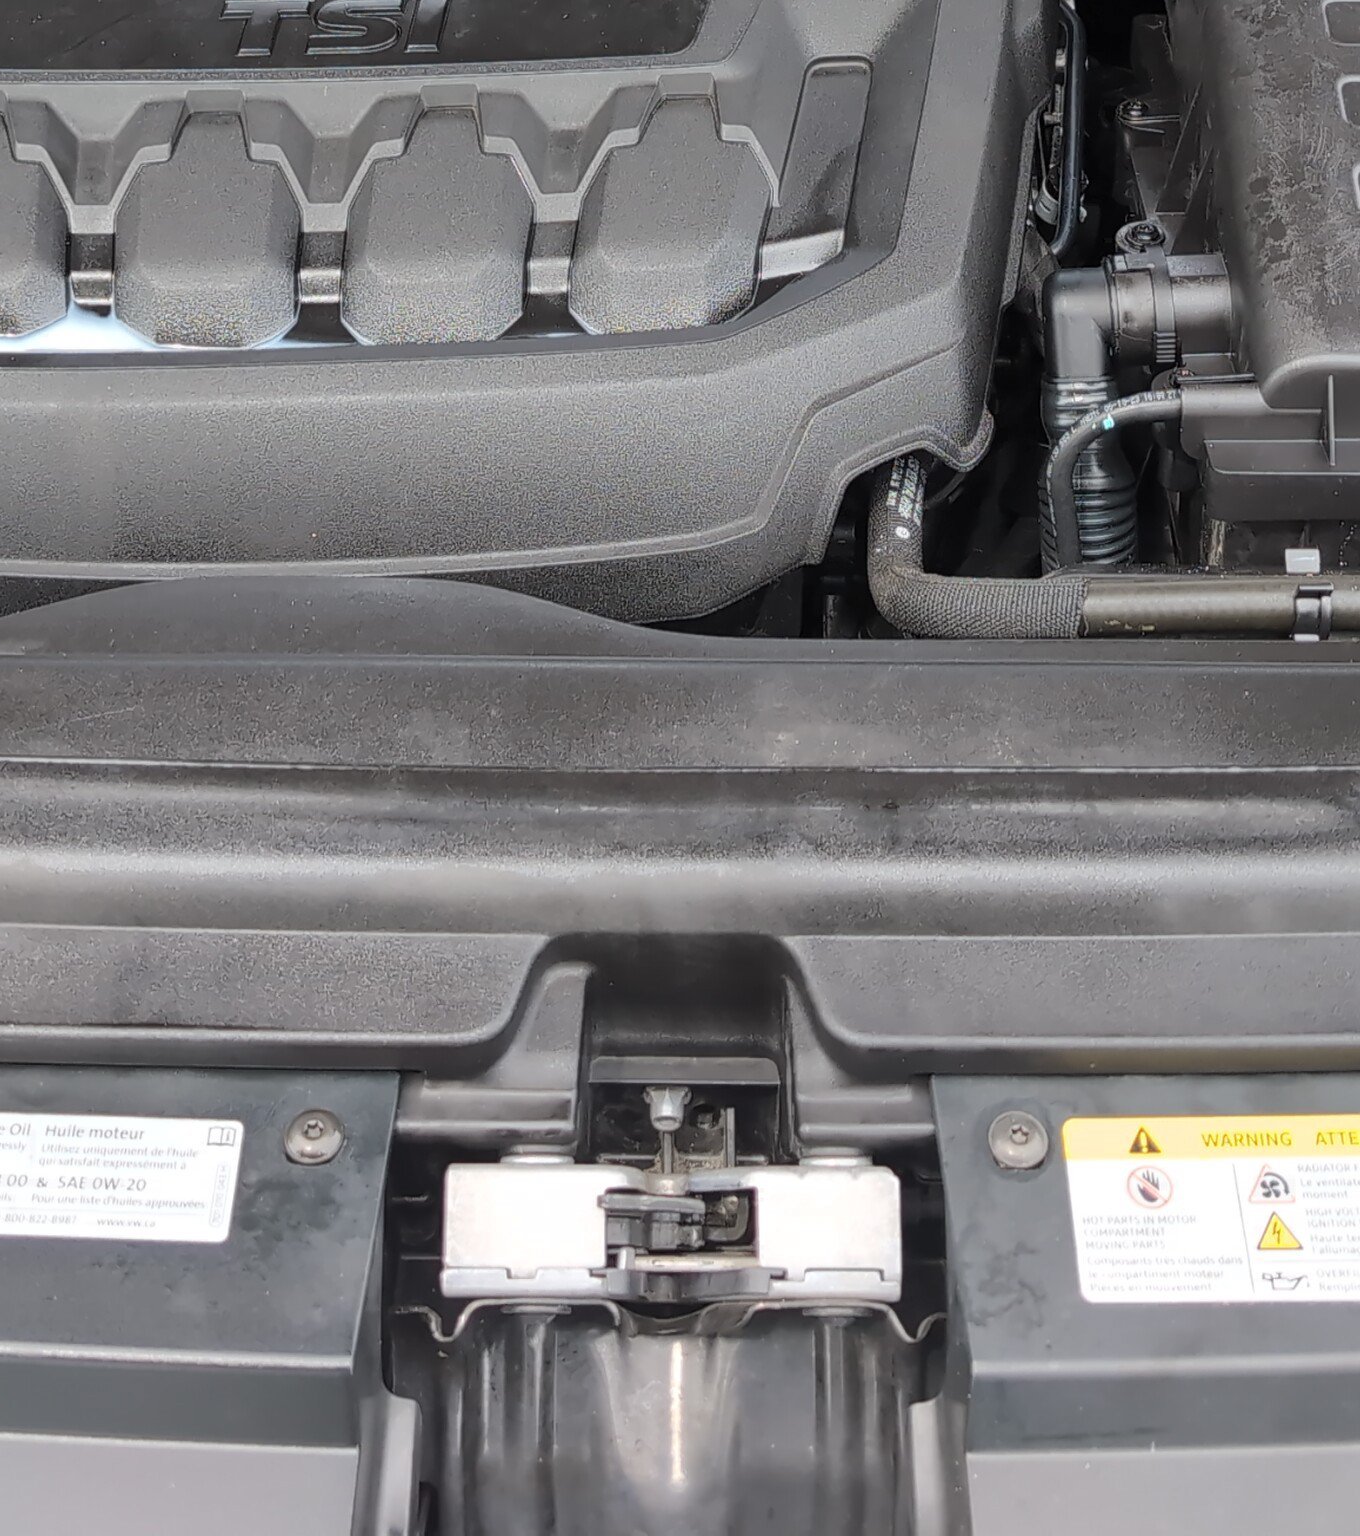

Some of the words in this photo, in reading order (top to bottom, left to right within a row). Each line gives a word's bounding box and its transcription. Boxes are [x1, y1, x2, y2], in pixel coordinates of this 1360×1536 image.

[9, 1123, 31, 1136] Oil
[45, 1125, 85, 1139] Huile
[89, 1126, 145, 1140] moteur
[1201, 1131, 1292, 1147] WARNING
[41, 1144, 80, 1154] Utilisez
[83, 1145, 147, 1157] uniquement
[150, 1146, 164, 1156] de
[39, 1157, 56, 1167] qui
[59, 1157, 100, 1167] satisfait
[1297, 1163, 1351, 1173] RADIATOR
[6, 1174, 28, 1187] 00
[36, 1177, 48, 1188] &
[57, 1176, 86, 1190] SAE
[92, 1176, 147, 1191] 0W-20
[1300, 1178, 1313, 1187] Le
[31, 1193, 55, 1204] Pour
[57, 1196, 78, 1205] une
[80, 1195, 99, 1205] liste
[1302, 1190, 1348, 1199] moment
[1305, 1207, 1332, 1216] HIGH
[96, 1217, 156, 1228] www.vw.ca
[1082, 1215, 1099, 1224] HOT
[1107, 1215, 1140, 1224] PARTS
[1143, 1215, 1155, 1224] IN
[1157, 1215, 1197, 1224] MOTOR
[1307, 1220, 1356, 1228] IGNITION
[1083, 1227, 1165, 1236] COMPARTMENT
[1310, 1233, 1343, 1242] Haute
[1085, 1240, 1129, 1249] MOVING
[1132, 1240, 1165, 1249] PARTS
[1087, 1256, 1152, 1266] Composants
[1178, 1255, 1215, 1265] chauds
[1218, 1255, 1243, 1265] dans
[1184, 1270, 1224, 1279] moteur
